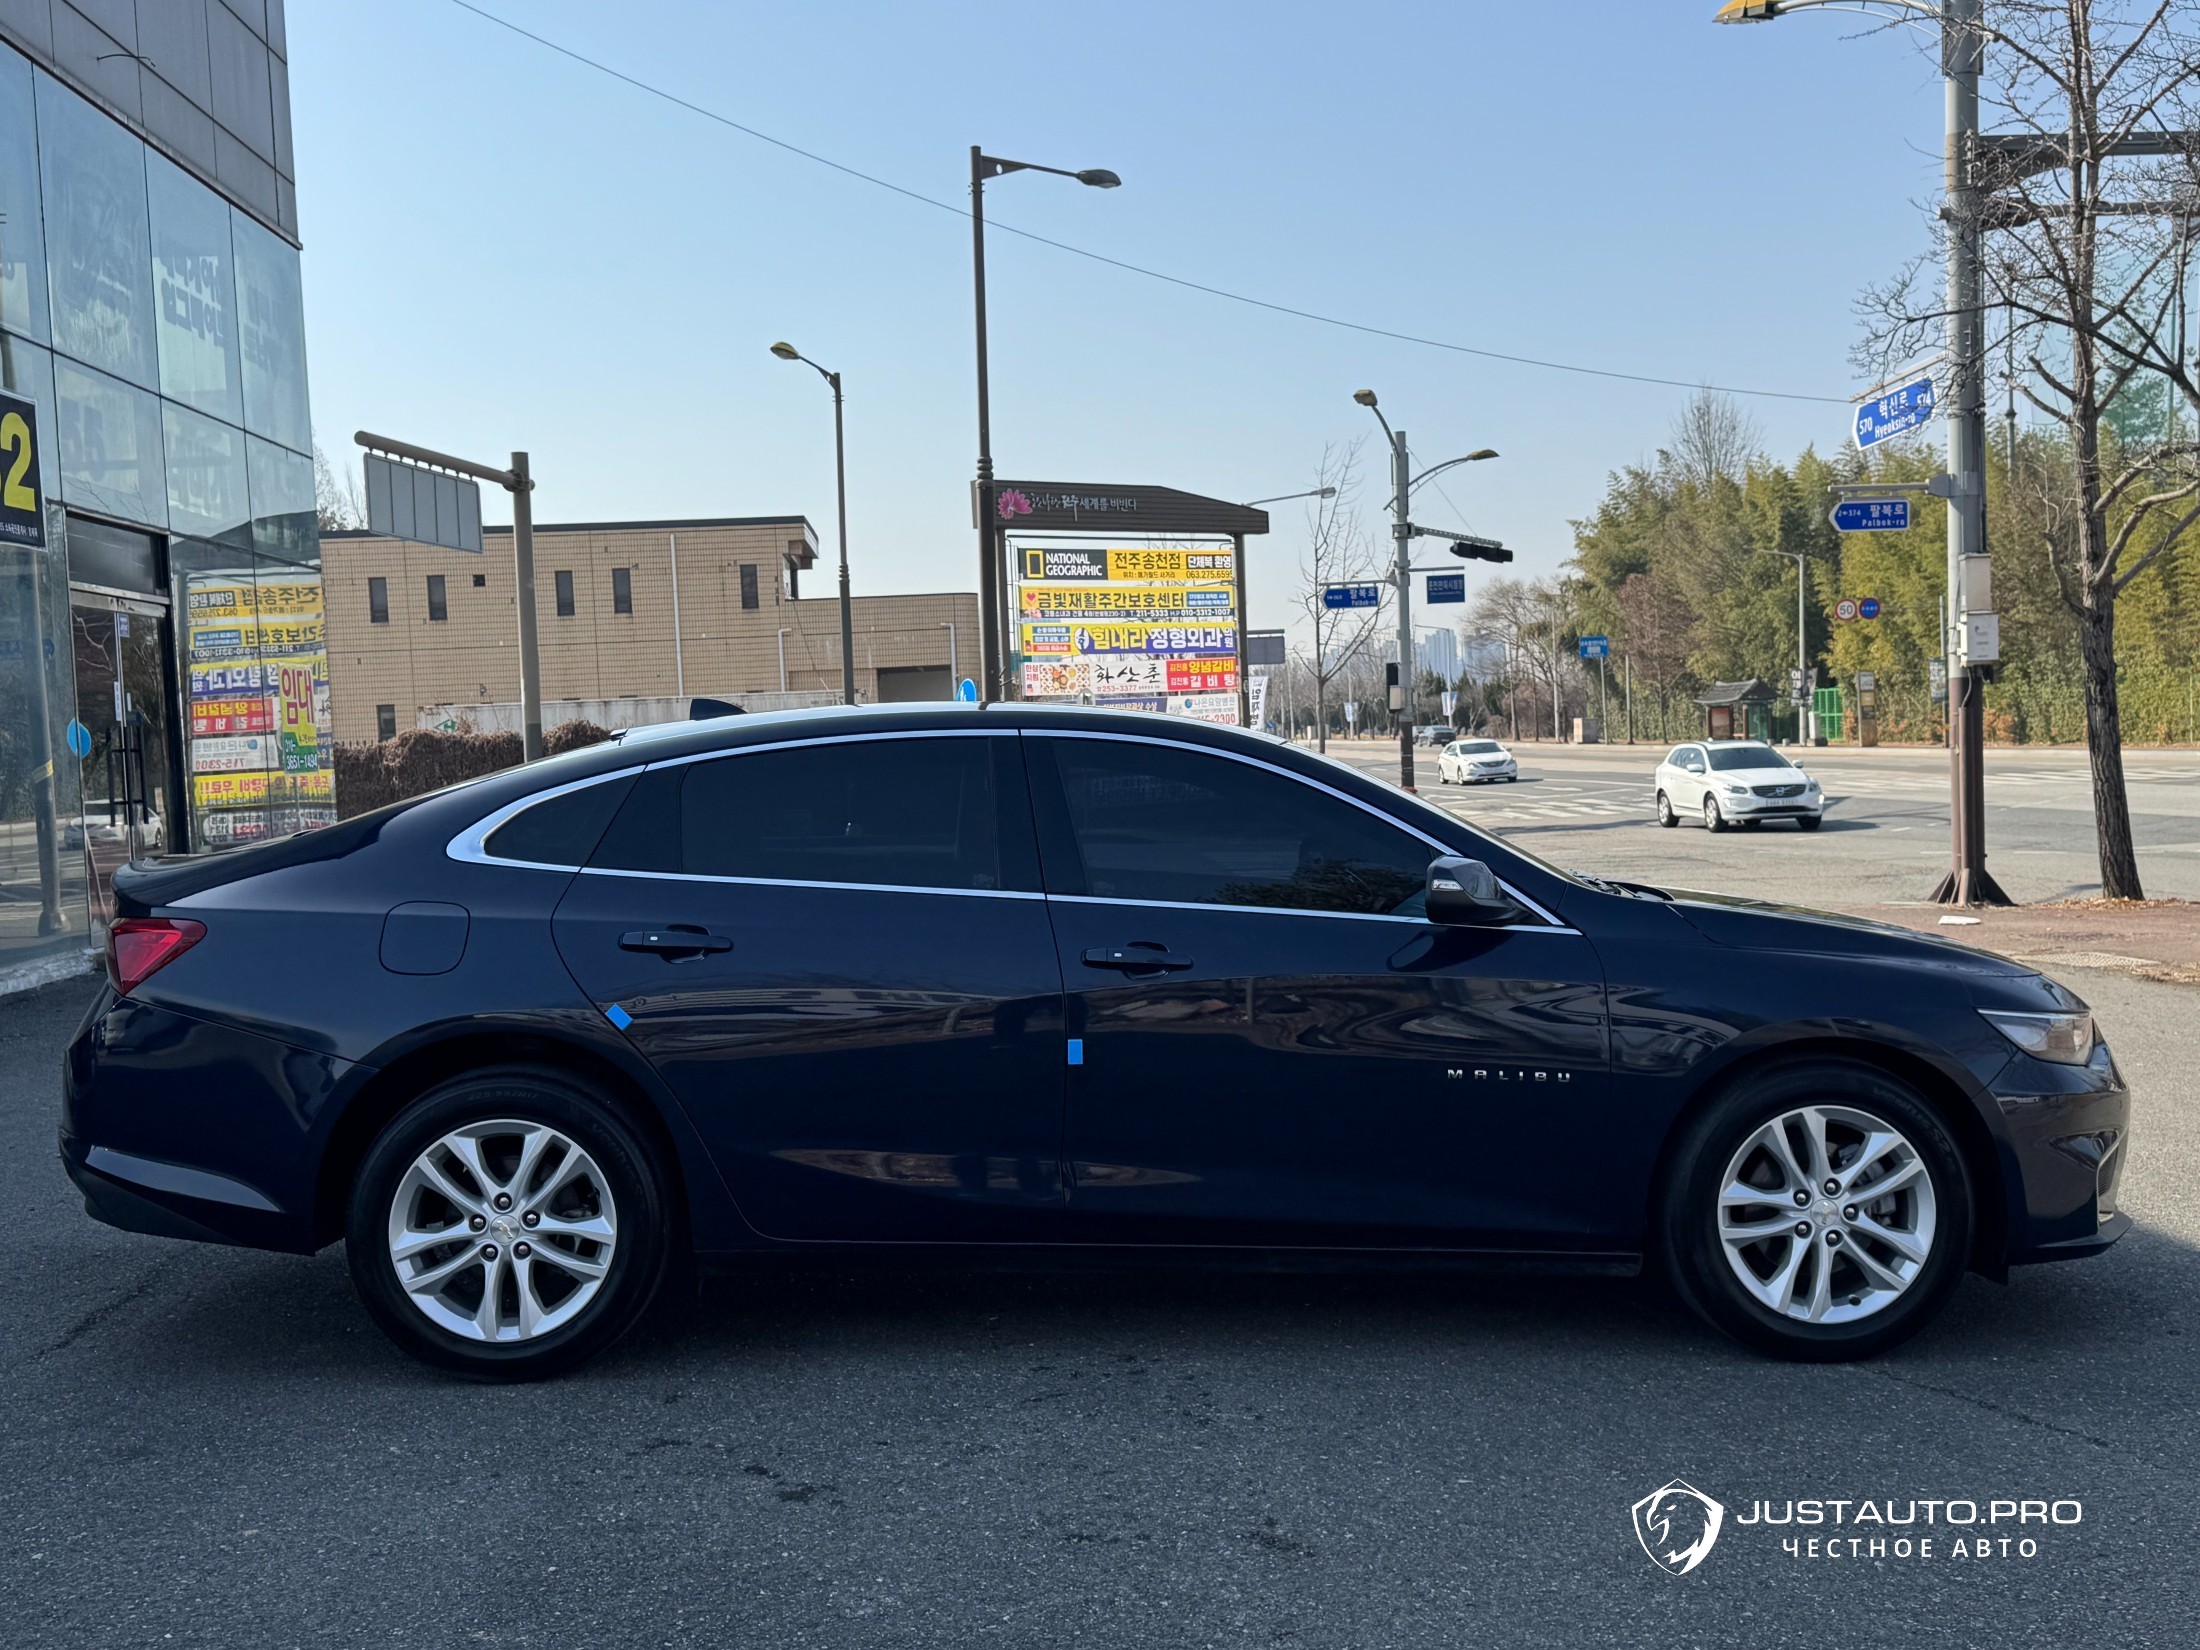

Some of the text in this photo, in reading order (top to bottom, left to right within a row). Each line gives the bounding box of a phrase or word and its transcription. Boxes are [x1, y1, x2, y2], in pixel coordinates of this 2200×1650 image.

[1879, 391, 1909, 420] 혁신로
[1859, 417, 1873, 435] 570
[0, 412, 36, 512] 2
[1080, 497, 1109, 511] 세계를
[1110, 498, 1137, 512] 비빈다
[1870, 504, 1905, 518] 팔복로
[1862, 519, 1905, 527] Palbok-ro
[1045, 553, 1091, 564] NATIONAL
[1114, 552, 1181, 570] 전주송천점
[1187, 555, 1232, 568] 단체복 환영
[1045, 565, 1103, 576] GEOGRAPHIC
[1038, 592, 1184, 609] 금빛재활주간보호센터
[1181, 608, 1231, 617] 010-3312-1007
[1839, 605, 1853, 615] 50
[1091, 626, 1234, 650] 힘내라 정형외과 의원
[1188, 660, 1235, 674] 양념갈비
[281, 667, 315, 725] 임대
[1447, 1069, 1570, 1082] MALIBU
